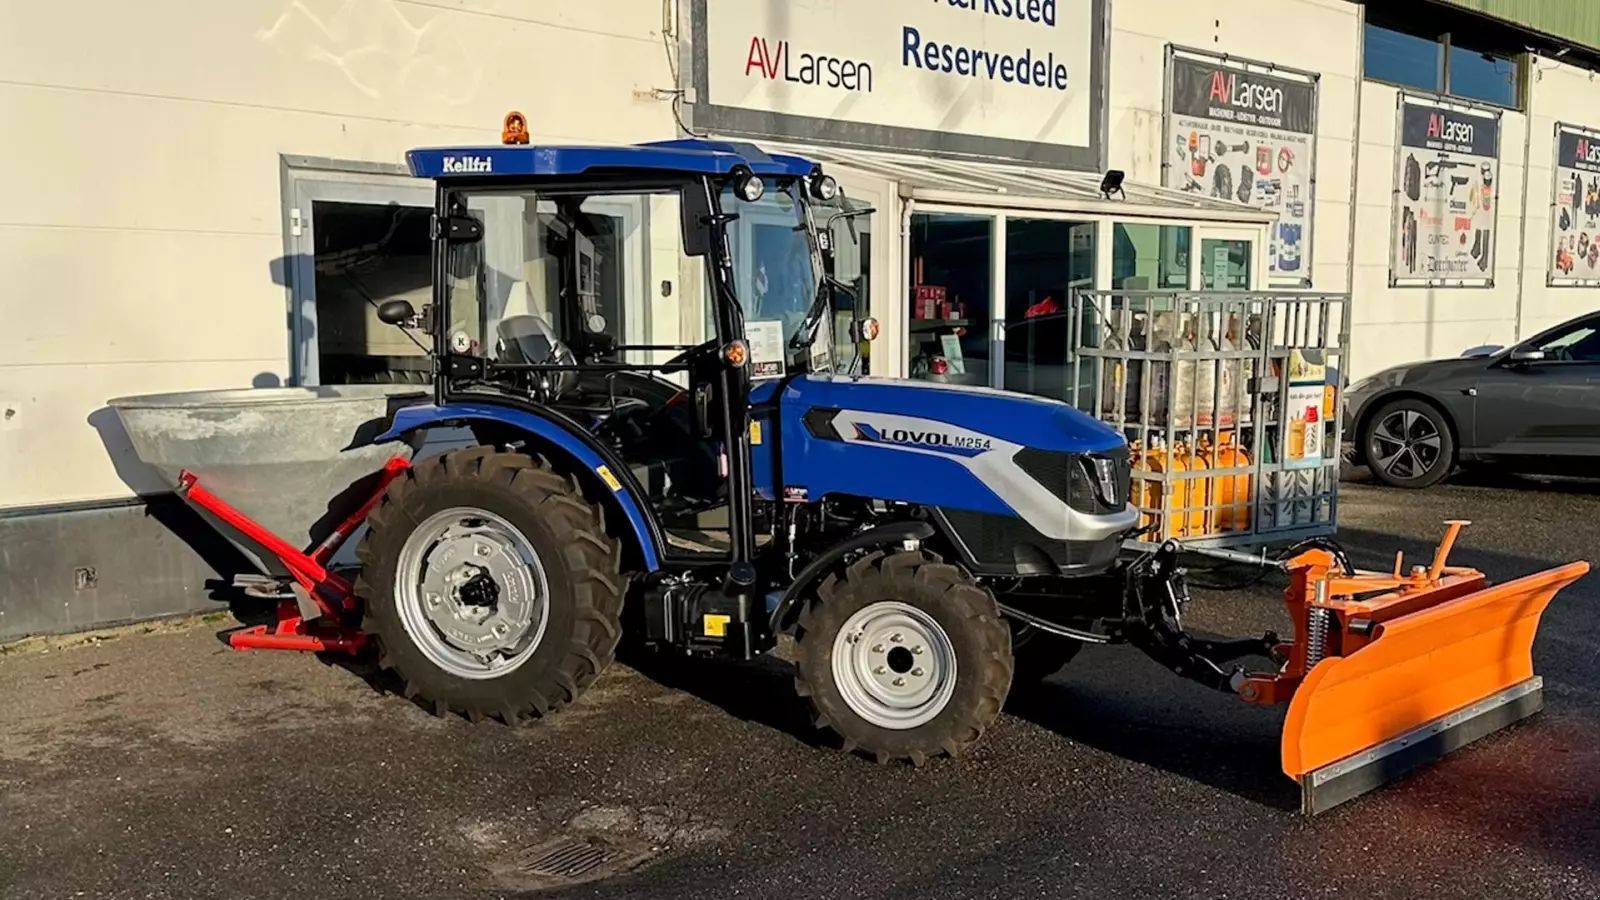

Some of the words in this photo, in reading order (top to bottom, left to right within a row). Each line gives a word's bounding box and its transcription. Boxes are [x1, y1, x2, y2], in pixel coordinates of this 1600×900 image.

[933, 0, 1056, 26] sted
[745, 36, 872, 92] AVLarsen
[902, 25, 1068, 91] Reservedele
[1209, 70, 1283, 113] AVLarsen
[442, 156, 492, 173] Kellfri
[880, 428, 953, 446] LOVOL
[954, 436, 991, 449] M254
